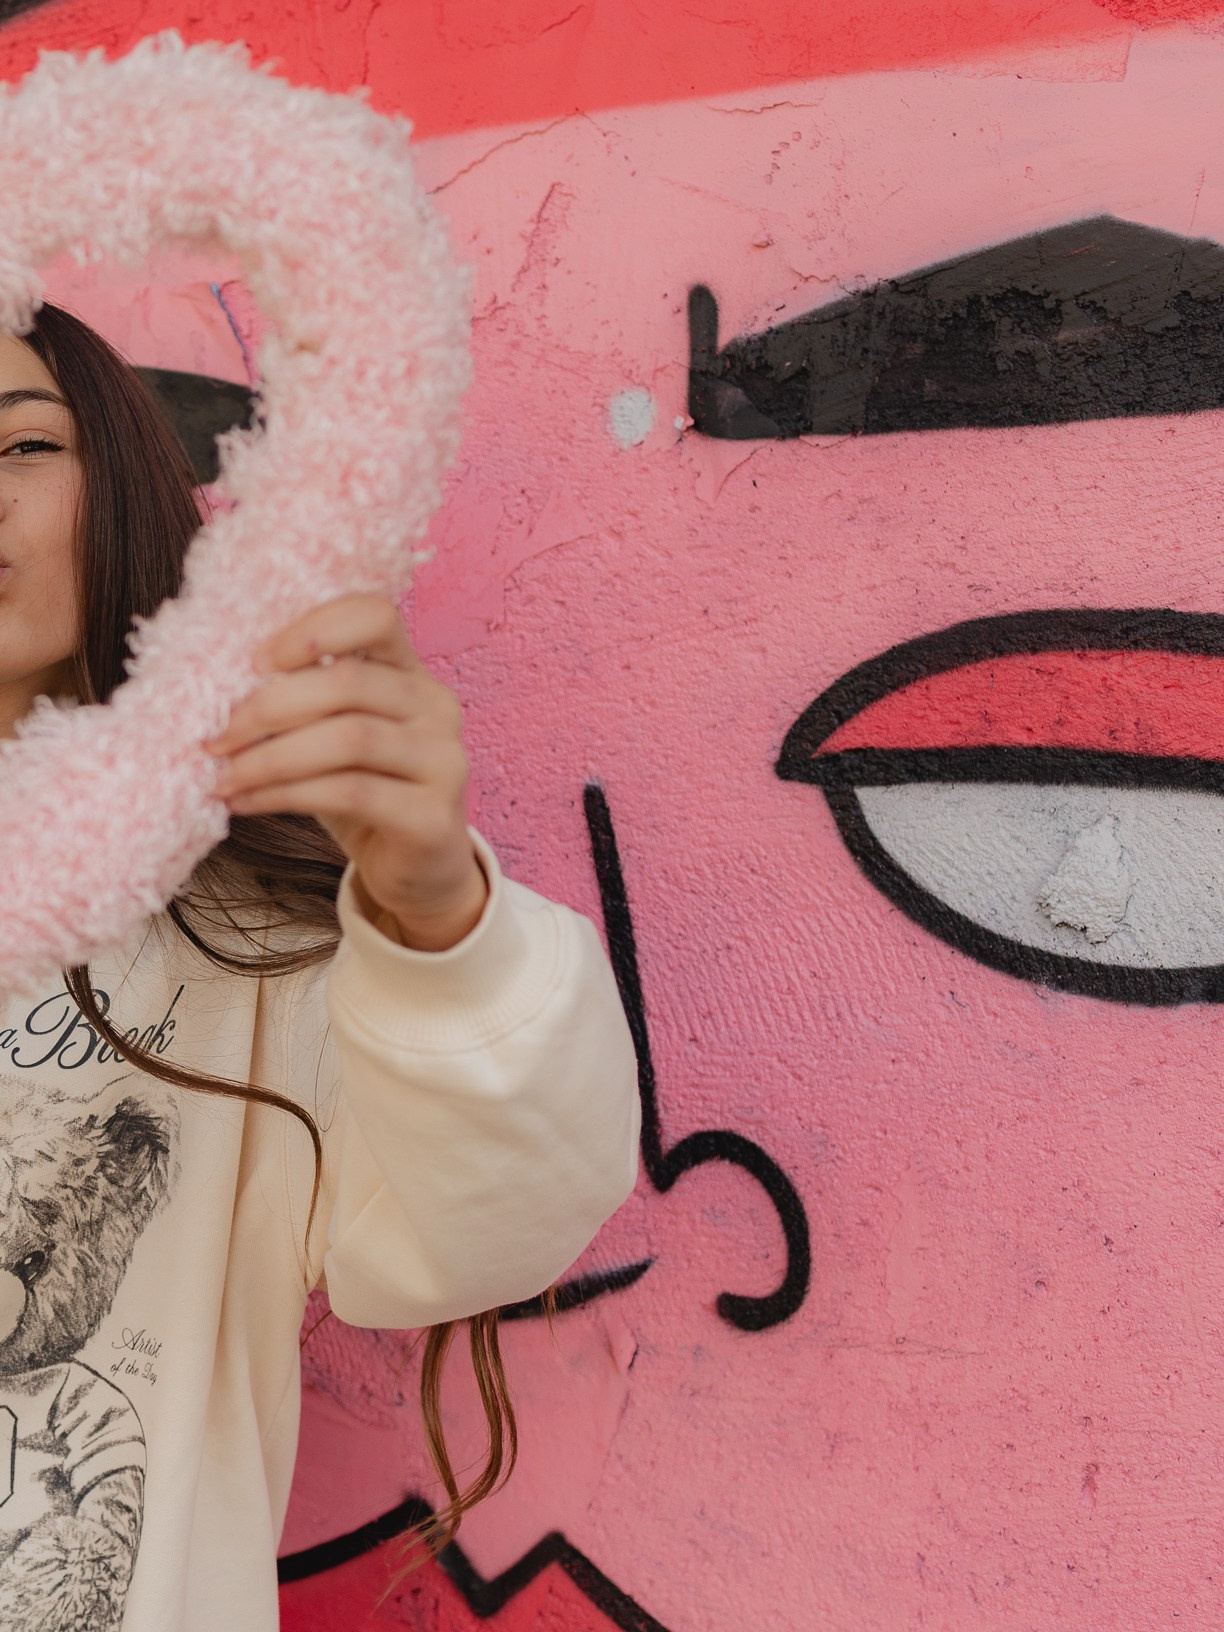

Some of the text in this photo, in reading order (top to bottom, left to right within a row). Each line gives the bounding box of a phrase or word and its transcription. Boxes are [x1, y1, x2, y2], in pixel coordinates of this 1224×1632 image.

[111, 1327, 163, 1358] Artist
[110, 1357, 126, 1376] of
[125, 1359, 140, 1376] the
